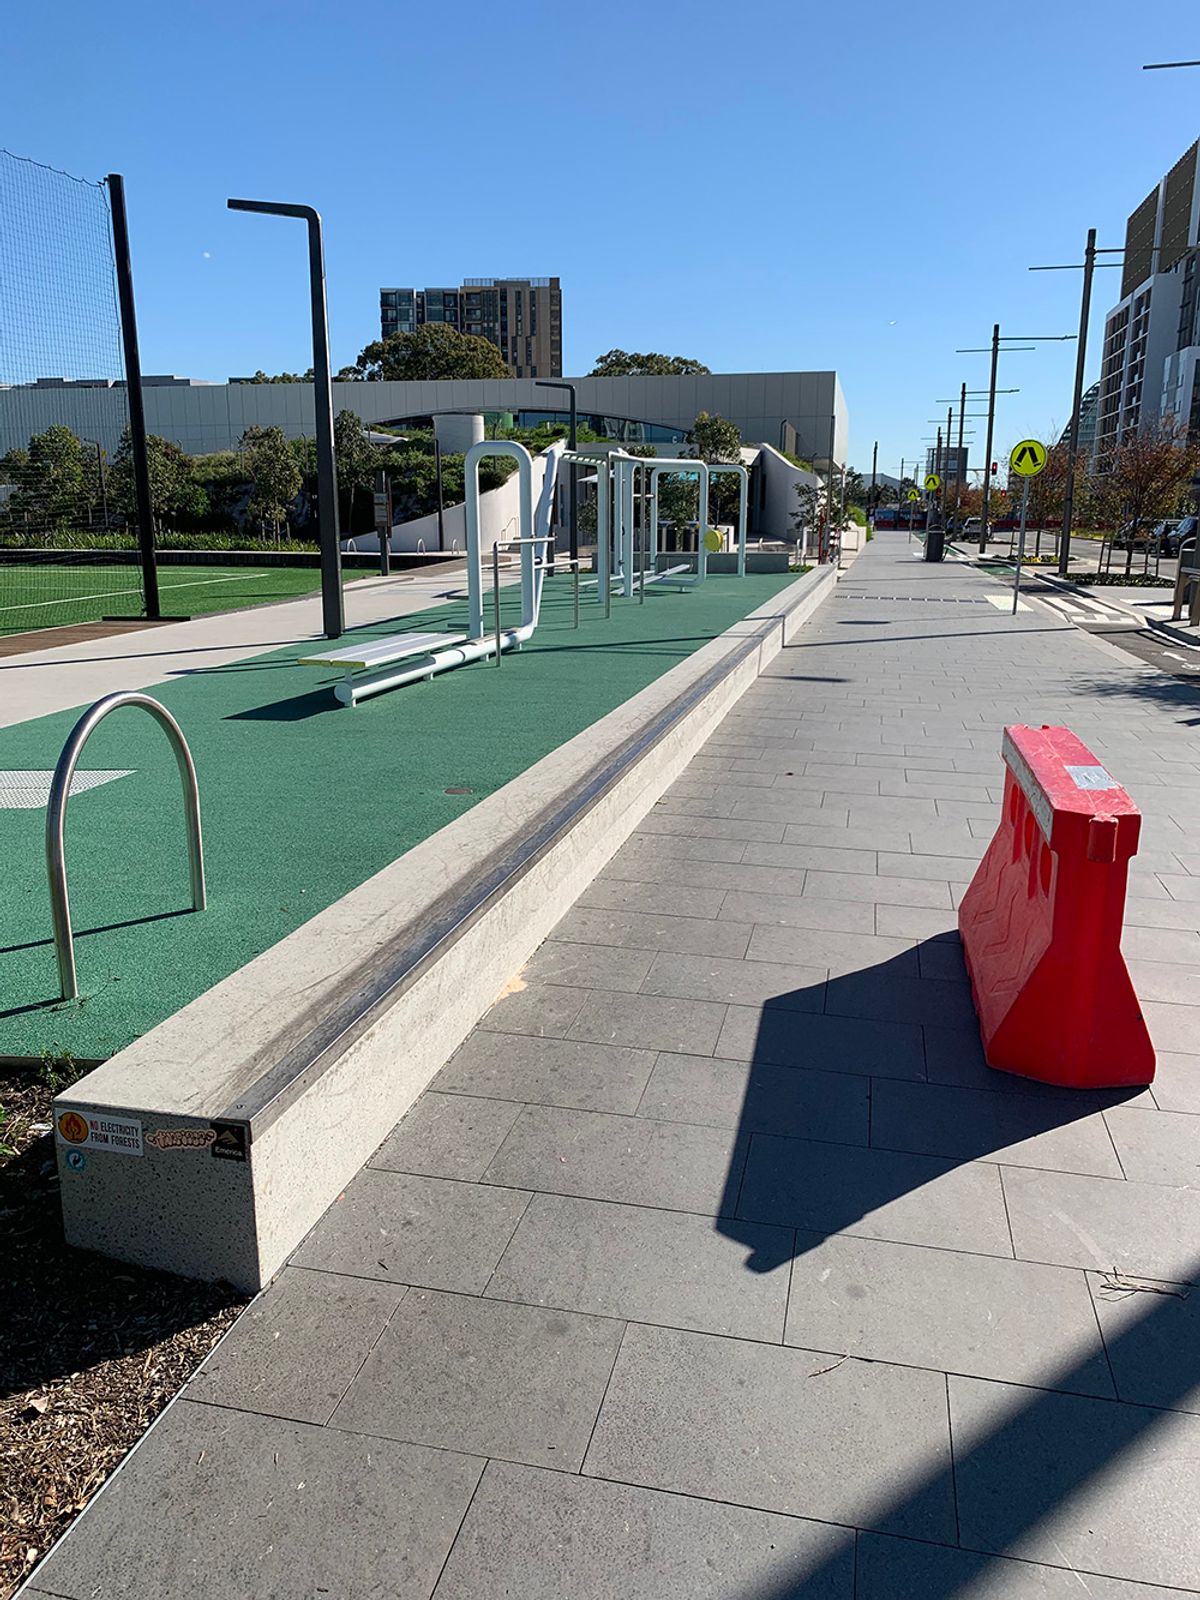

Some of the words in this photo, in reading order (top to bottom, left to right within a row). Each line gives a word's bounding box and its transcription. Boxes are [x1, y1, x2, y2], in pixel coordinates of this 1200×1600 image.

[90, 1120, 98, 1130] NO
[100, 1122, 139, 1136] ELECTRICITY
[91, 1132, 109, 1144] FROM
[111, 1135, 140, 1149] FORESTS
